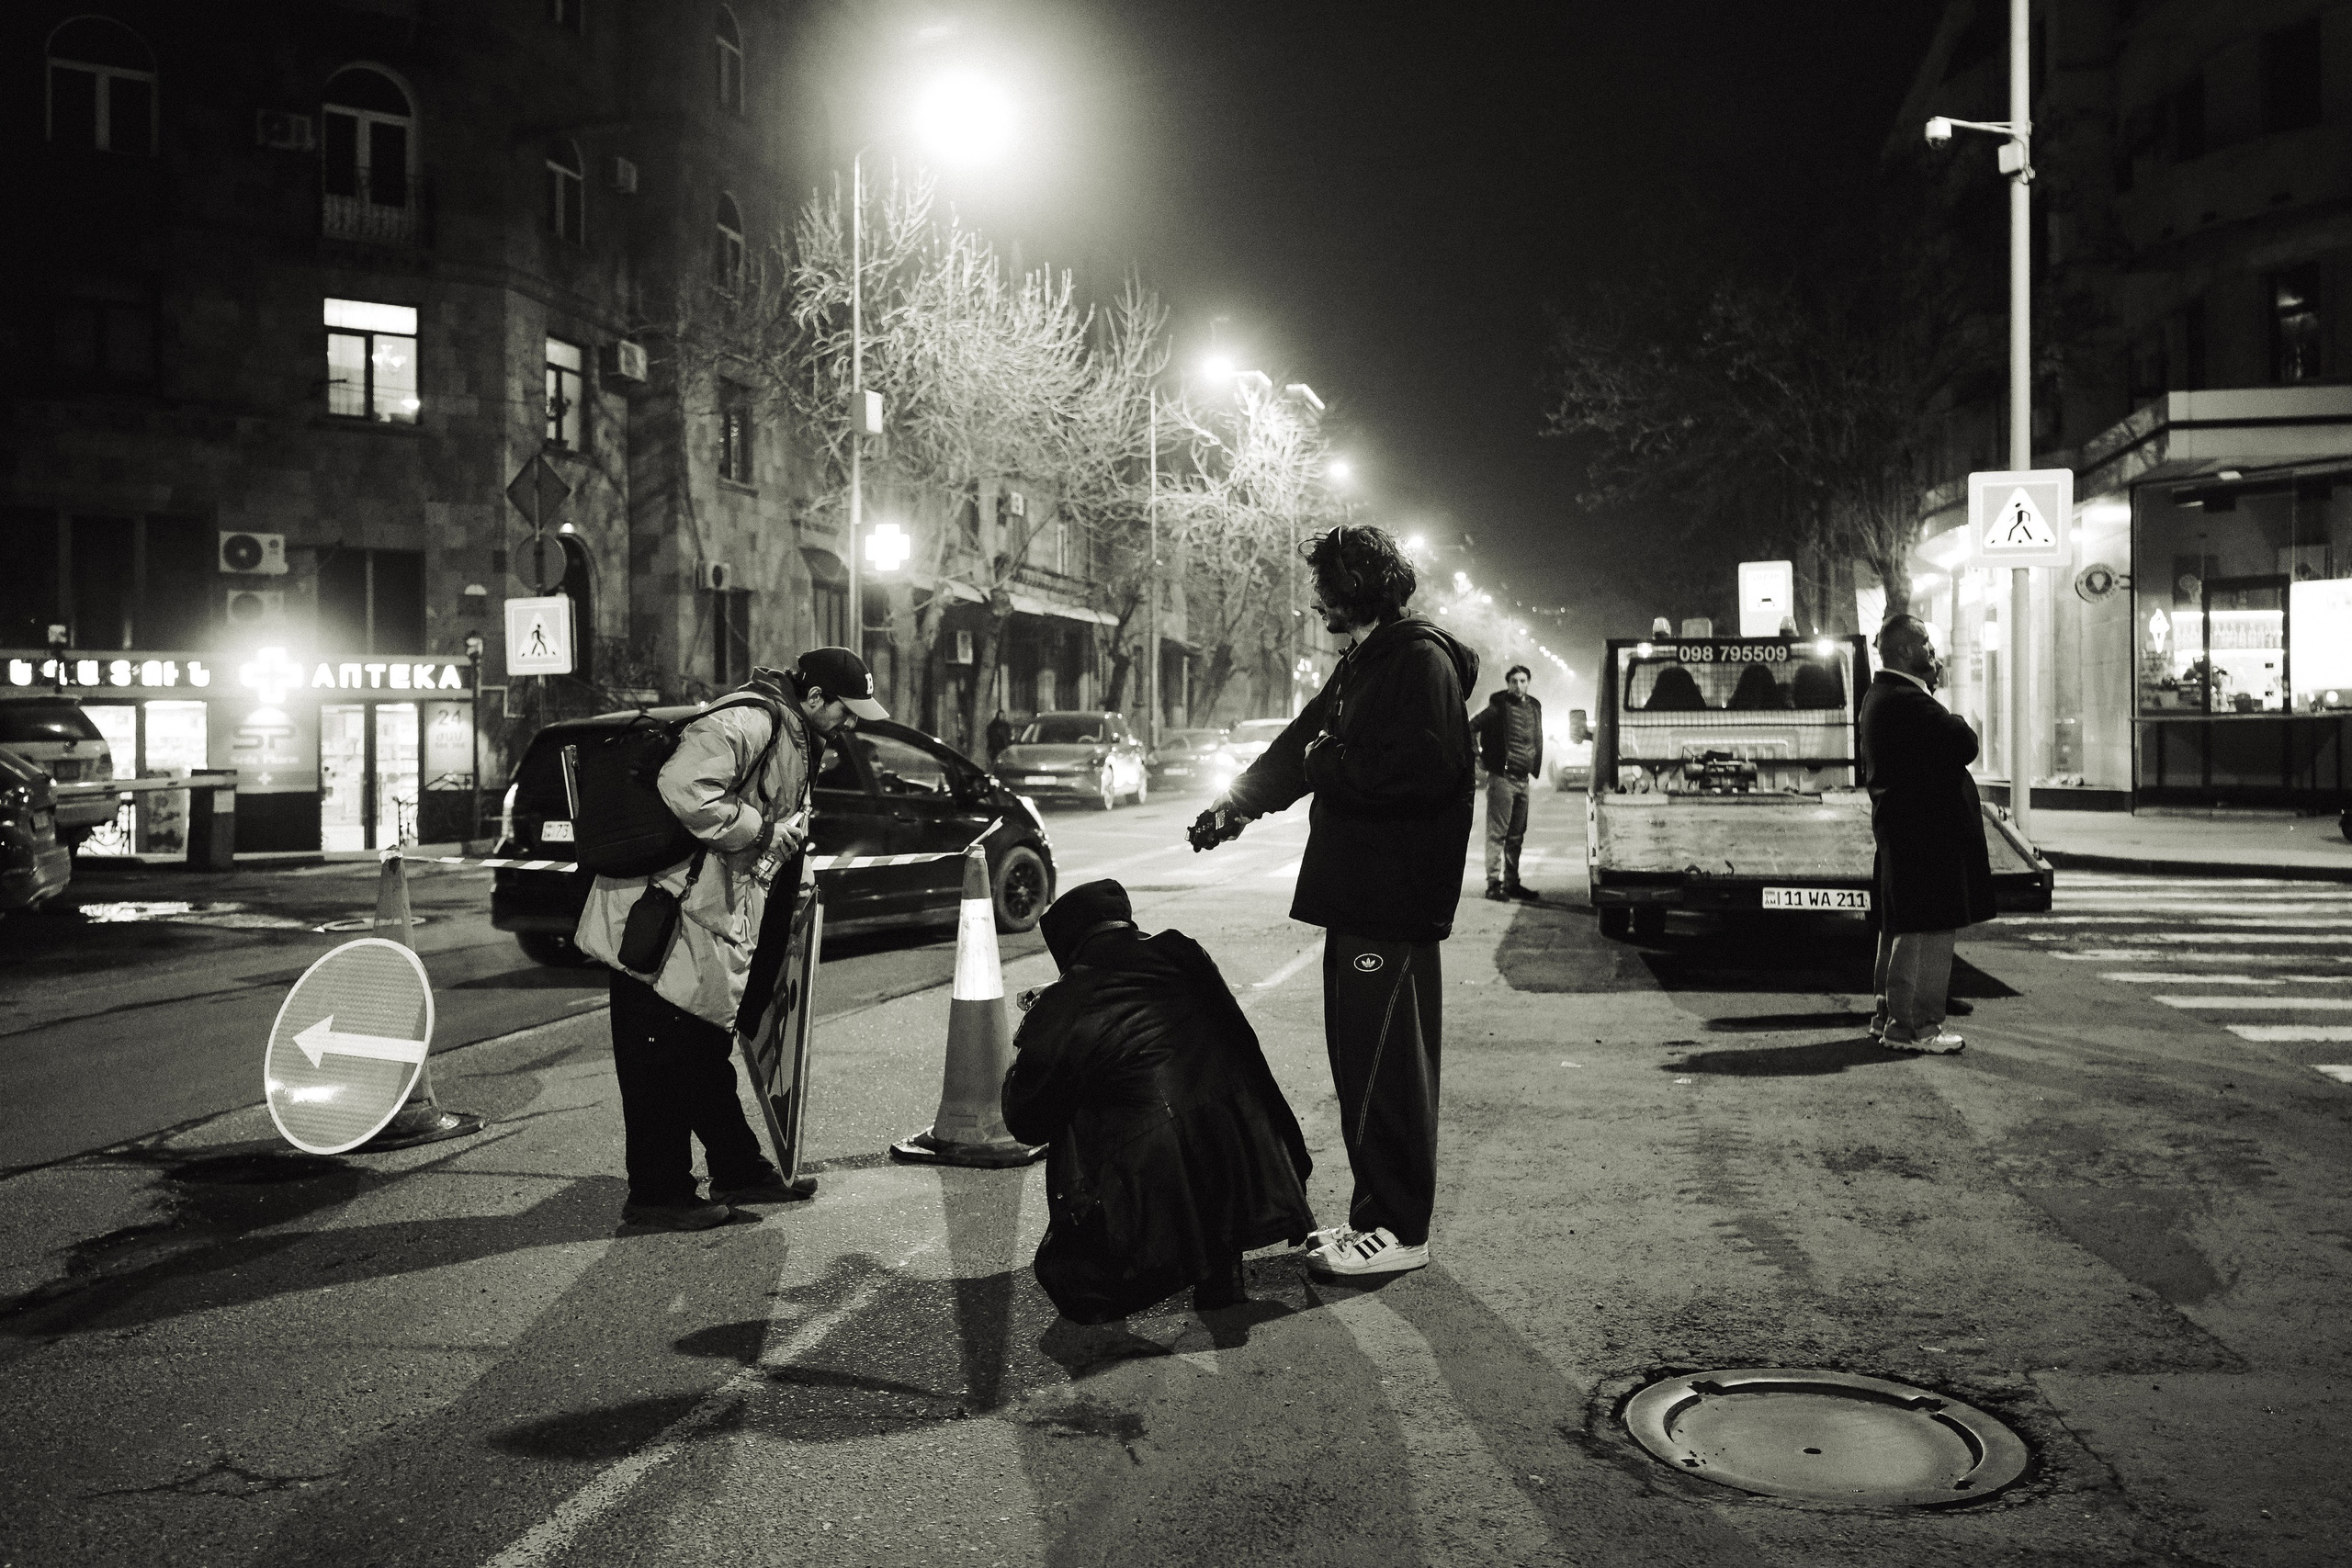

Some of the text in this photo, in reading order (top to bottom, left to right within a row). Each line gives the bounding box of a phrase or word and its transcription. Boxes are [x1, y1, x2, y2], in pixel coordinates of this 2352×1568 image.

[1679, 646, 1713, 661] 098
[311, 662, 462, 689] АПТЕКА
[1784, 890, 1803, 907] 11
[1808, 891, 1831, 907] WA
[1837, 892, 1866, 908] 211
